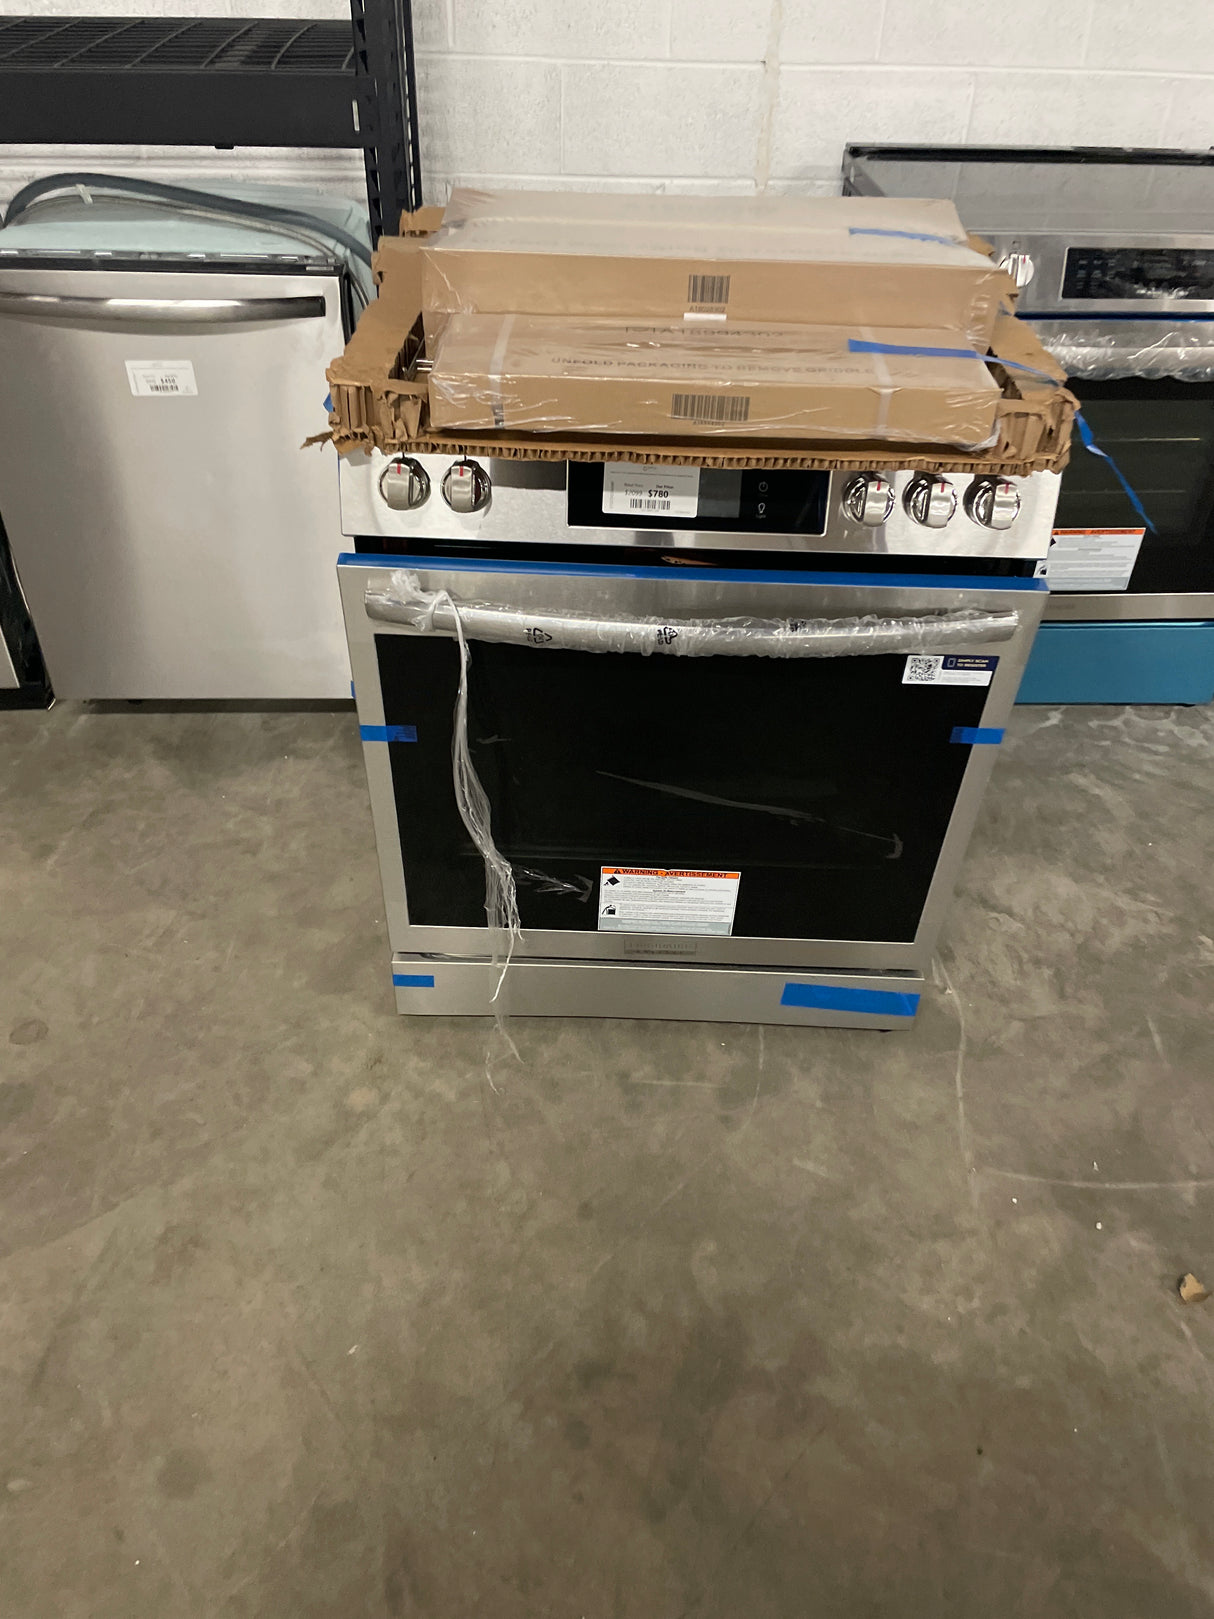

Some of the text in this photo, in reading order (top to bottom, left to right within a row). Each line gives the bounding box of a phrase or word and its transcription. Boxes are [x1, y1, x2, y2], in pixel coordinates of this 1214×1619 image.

[551, 357, 614, 367] UNFOLD
[617, 361, 709, 370] PACKAGING
[647, 489, 669, 498] $780
[664, 870, 729, 879] AVERTISSEMENT
